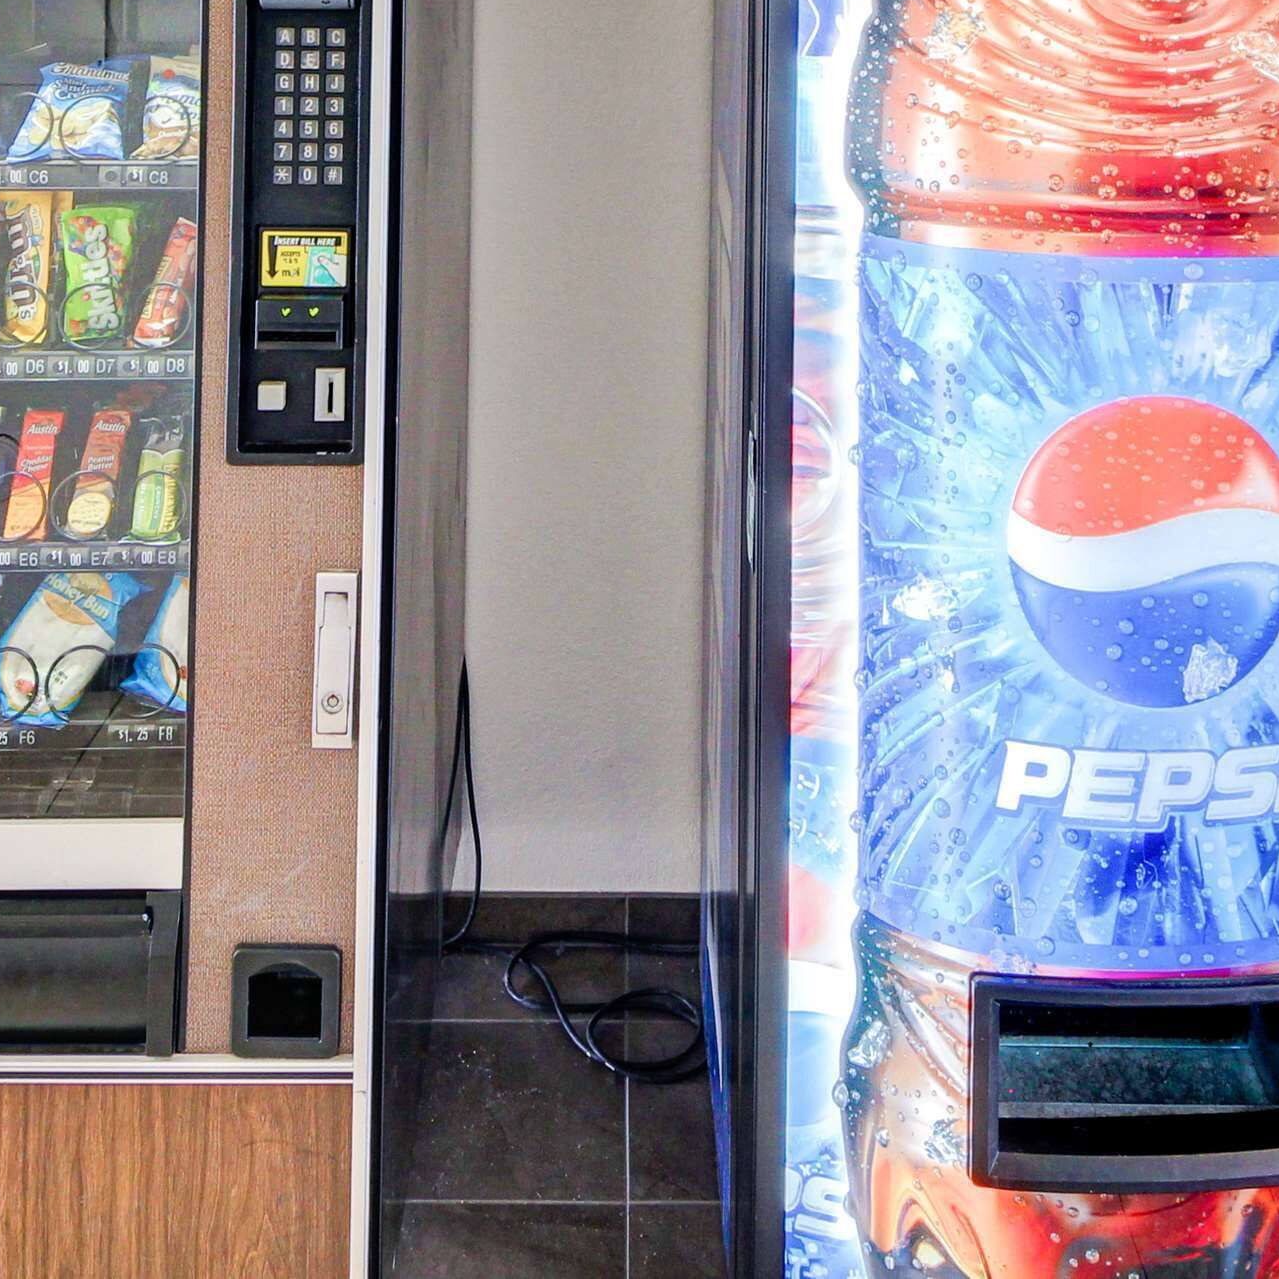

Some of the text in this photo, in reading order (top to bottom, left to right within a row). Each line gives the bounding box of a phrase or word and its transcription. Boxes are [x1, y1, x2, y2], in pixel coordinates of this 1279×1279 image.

[279, 31, 341, 43] A B C
[280, 54, 339, 66] D E F
[279, 78, 338, 89] G H J
[280, 100, 338, 112] 1 2 3
[278, 123, 337, 134] 4 5 6
[279, 146, 337, 158] 7 8 9
[29, 171, 49, 185] C6
[149, 171, 168, 185] C8
[303, 170, 311, 181] 0
[274, 235, 336, 246] INSERT BILL HERE
[84, 224, 120, 331] Skittles
[26, 360, 45, 374] D6
[58, 359, 115, 375] $1.00 D7
[166, 359, 185, 373] D8
[27, 423, 58, 435] Austin
[96, 420, 126, 433] Austin
[88, 455, 115, 464] Peanut
[88, 461, 113, 470] Butter
[20, 553, 38, 567] E6
[51, 551, 109, 566] $1.00 E7
[158, 550, 176, 564] E8
[47, 573, 111, 620] Honey Bun
[20, 730, 35, 744] F6
[118, 727, 173, 742] $1.25 F8
